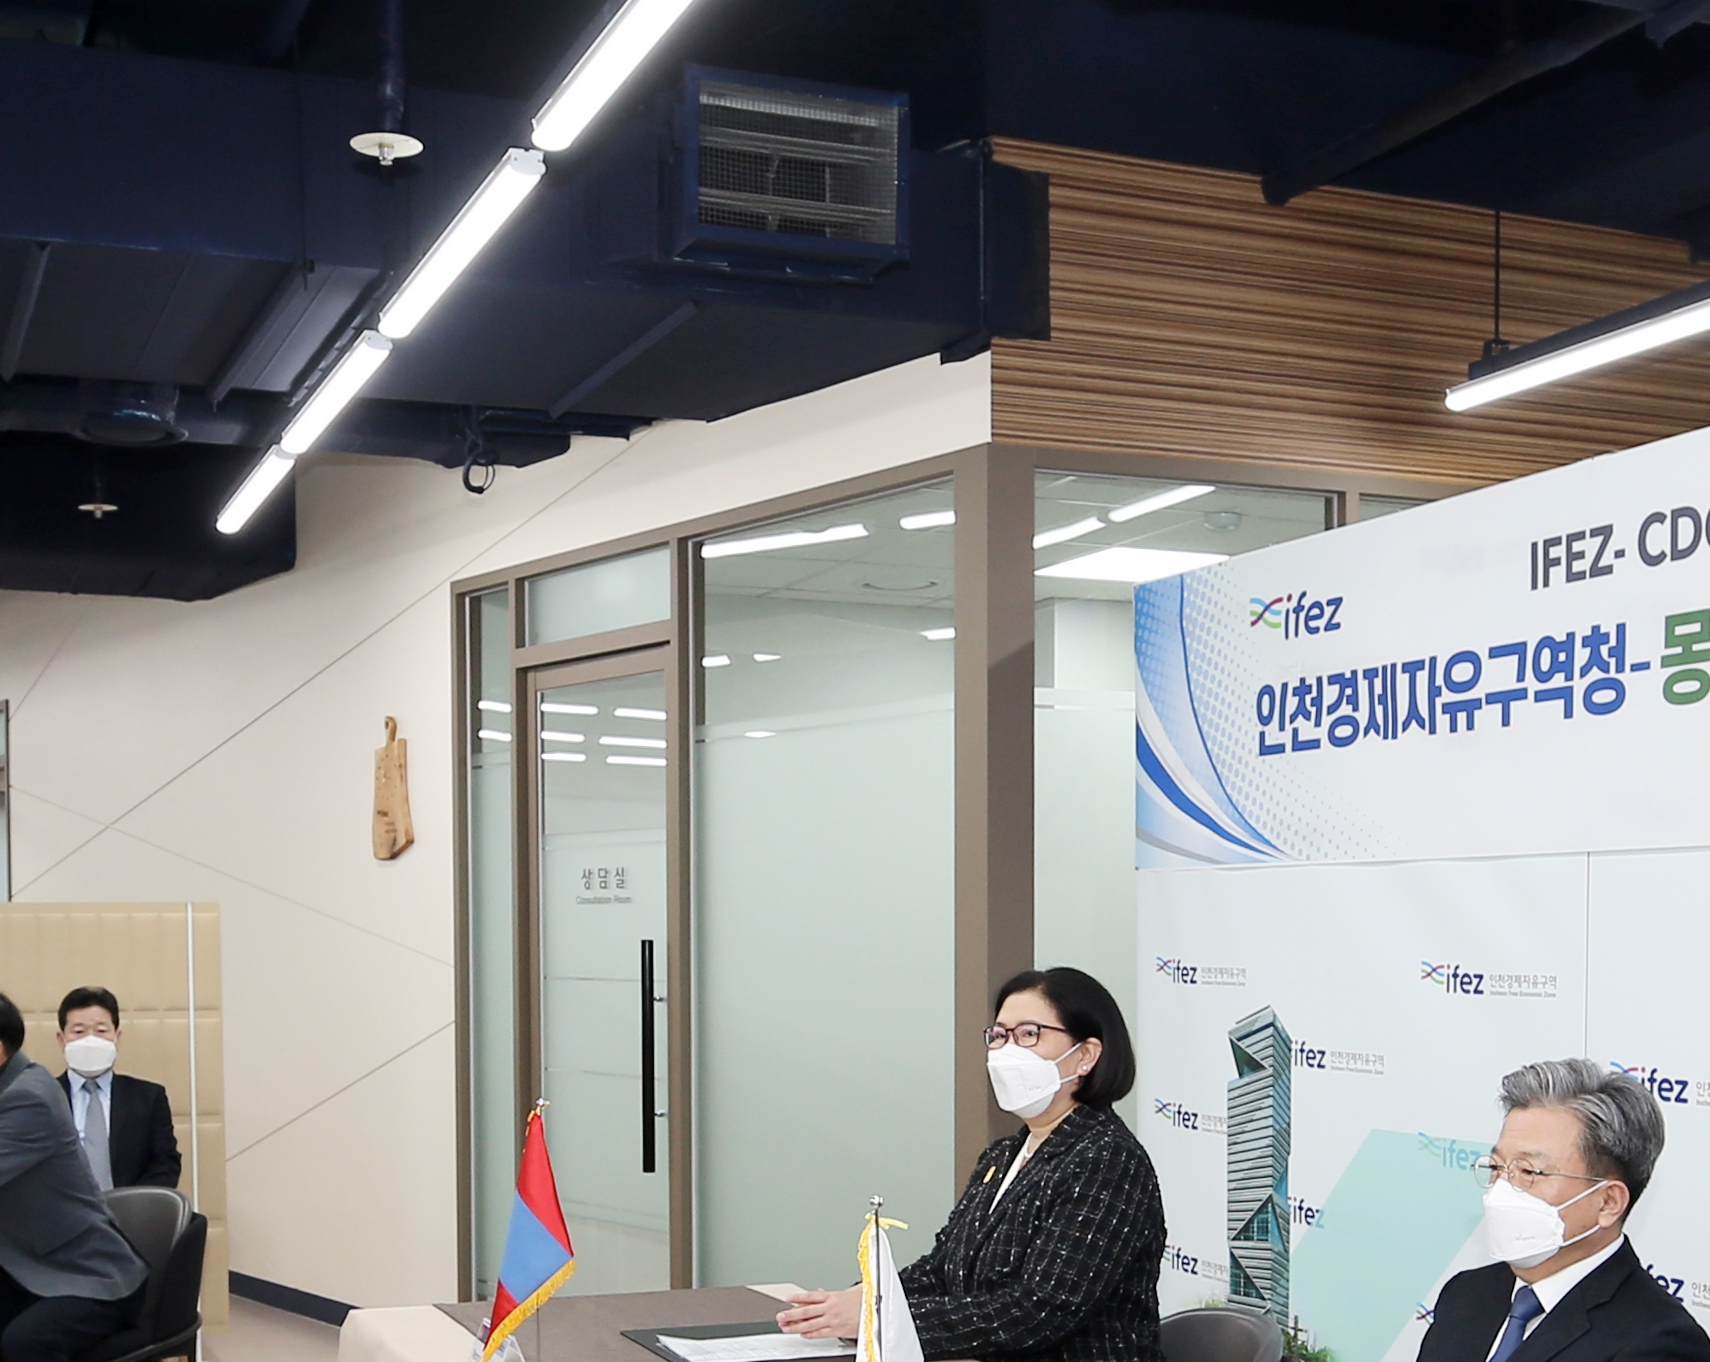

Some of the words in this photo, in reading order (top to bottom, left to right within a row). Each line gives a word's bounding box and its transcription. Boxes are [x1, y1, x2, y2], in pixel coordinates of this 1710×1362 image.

[1530, 523, 1626, 591] IFEZ-
[1283, 590, 1344, 640] ifez
[1446, 964, 1484, 994] ifez
[1294, 1040, 1326, 1069] ifez
